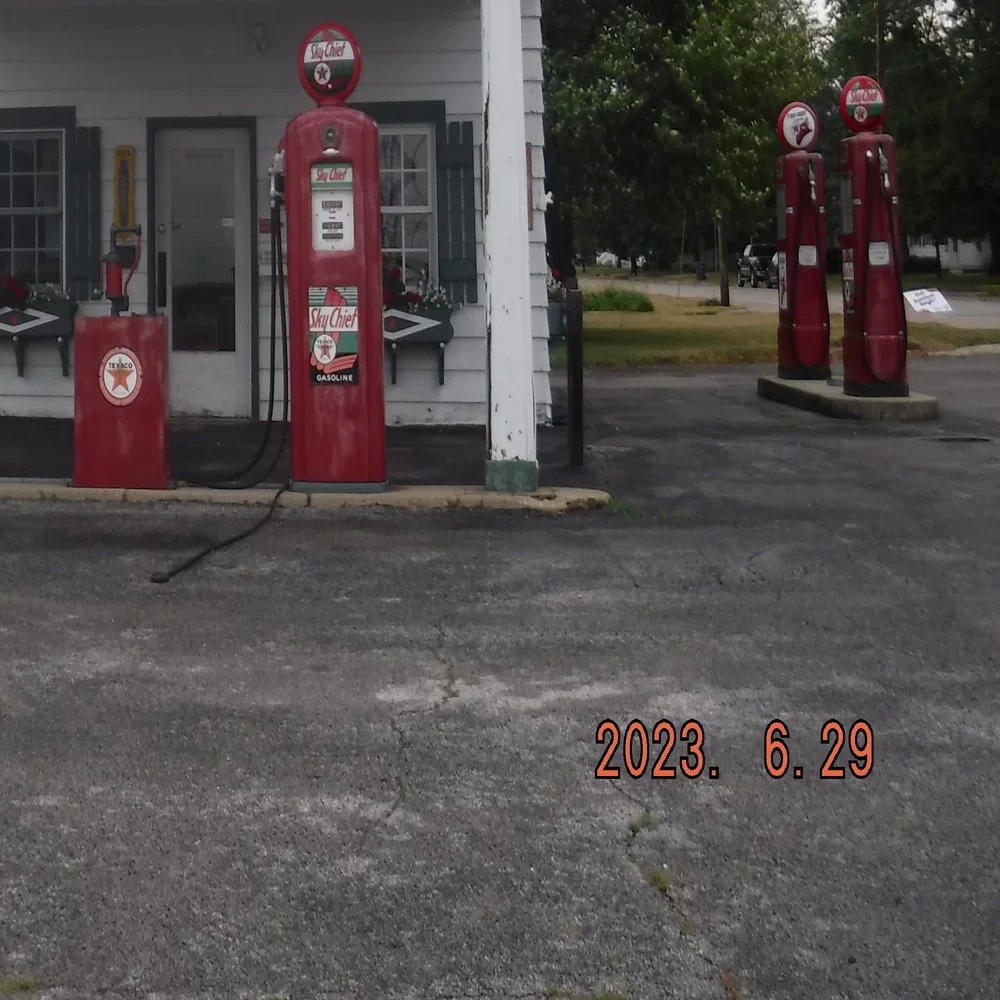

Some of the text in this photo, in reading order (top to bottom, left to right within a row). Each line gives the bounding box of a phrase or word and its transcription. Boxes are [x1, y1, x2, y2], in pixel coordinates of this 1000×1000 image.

[309, 307, 358, 333] Sky Chief
[316, 374, 353, 382] GASOLINE
